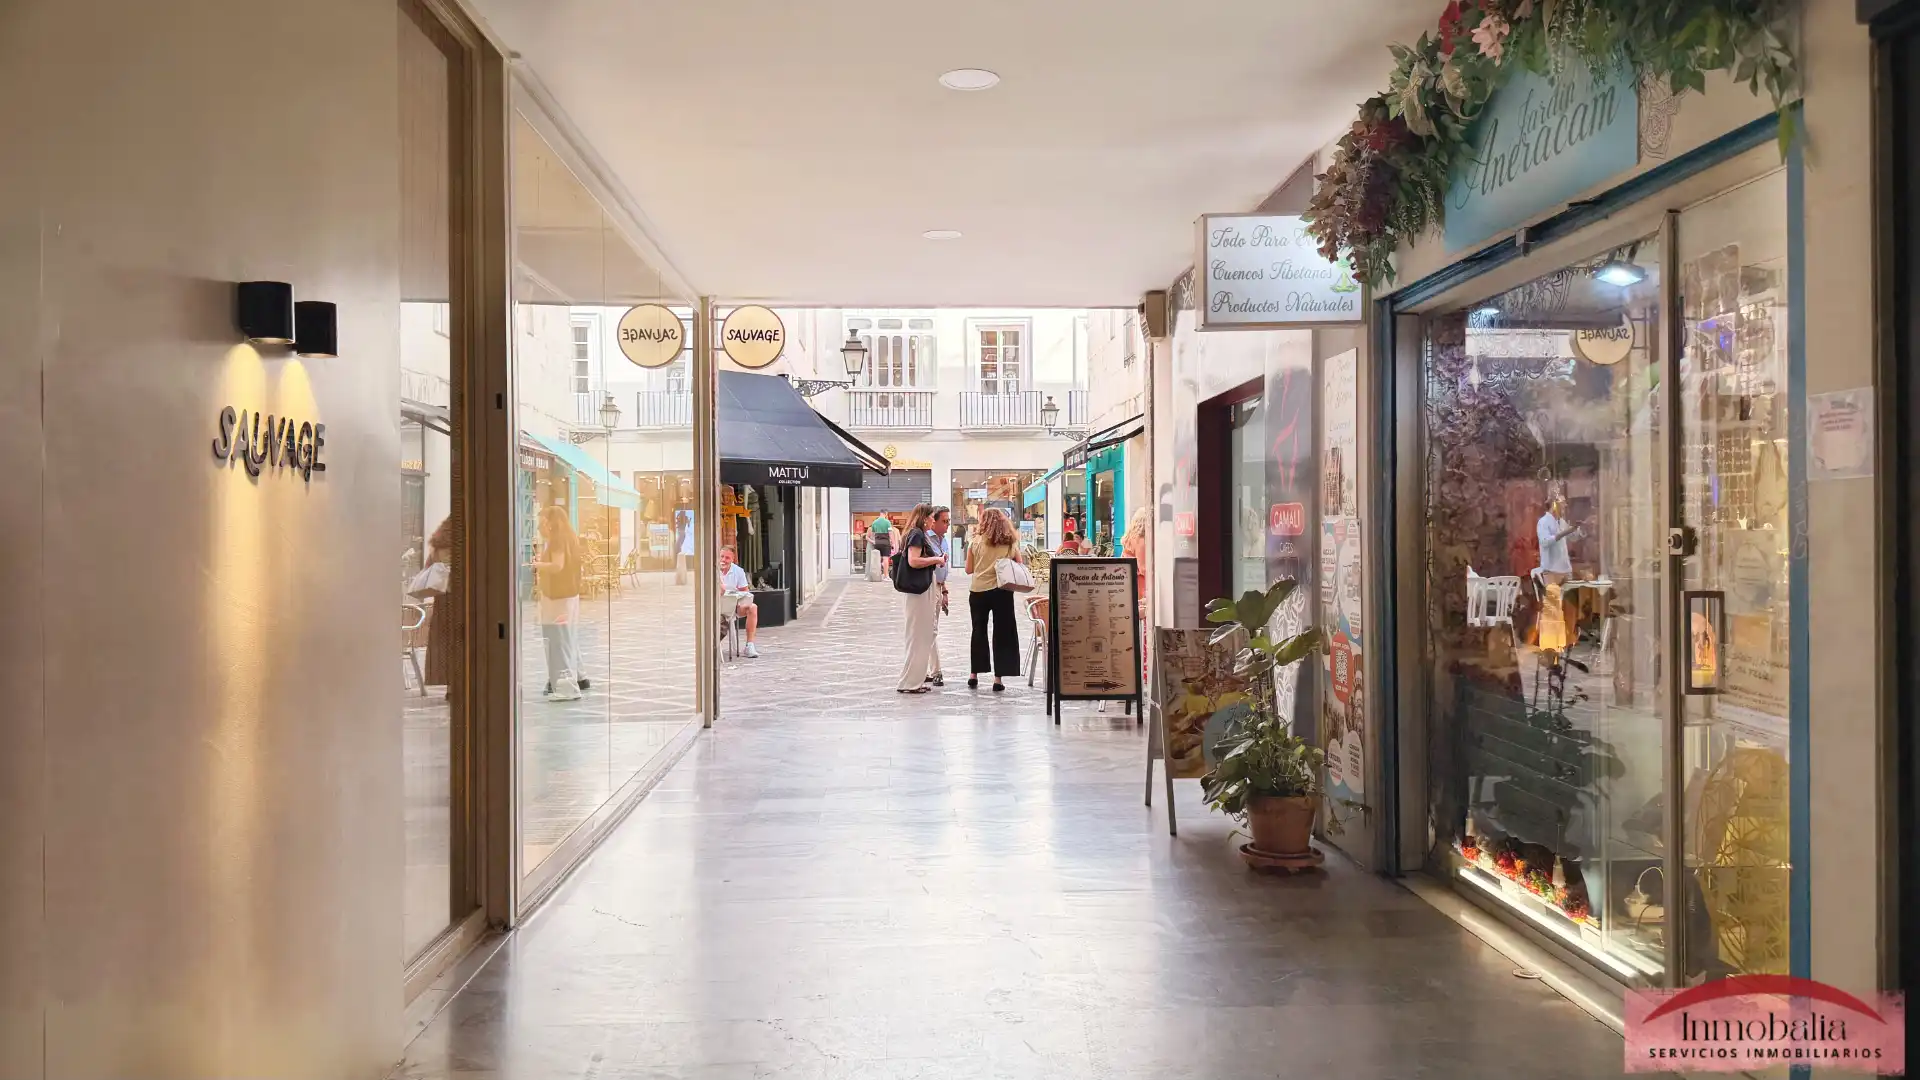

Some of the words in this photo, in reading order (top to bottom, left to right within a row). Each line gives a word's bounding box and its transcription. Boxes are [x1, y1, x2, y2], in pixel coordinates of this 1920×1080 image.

[1455, 86, 1622, 210] Aneracam
[1210, 227, 1247, 248] Todo
[1250, 224, 1290, 248] Para
[1211, 259, 1264, 281] Cuencos
[1269, 259, 1332, 281] Tibetanos
[1211, 290, 1280, 313] Productos
[1285, 291, 1353, 312] Naturales
[726, 329, 780, 344] SAUVAGE
[212, 405, 326, 482] SAUVAGE
[1273, 510, 1300, 528] CAMALI
[1060, 573, 1067, 581] El
[1101, 573, 1124, 581] Antonio
